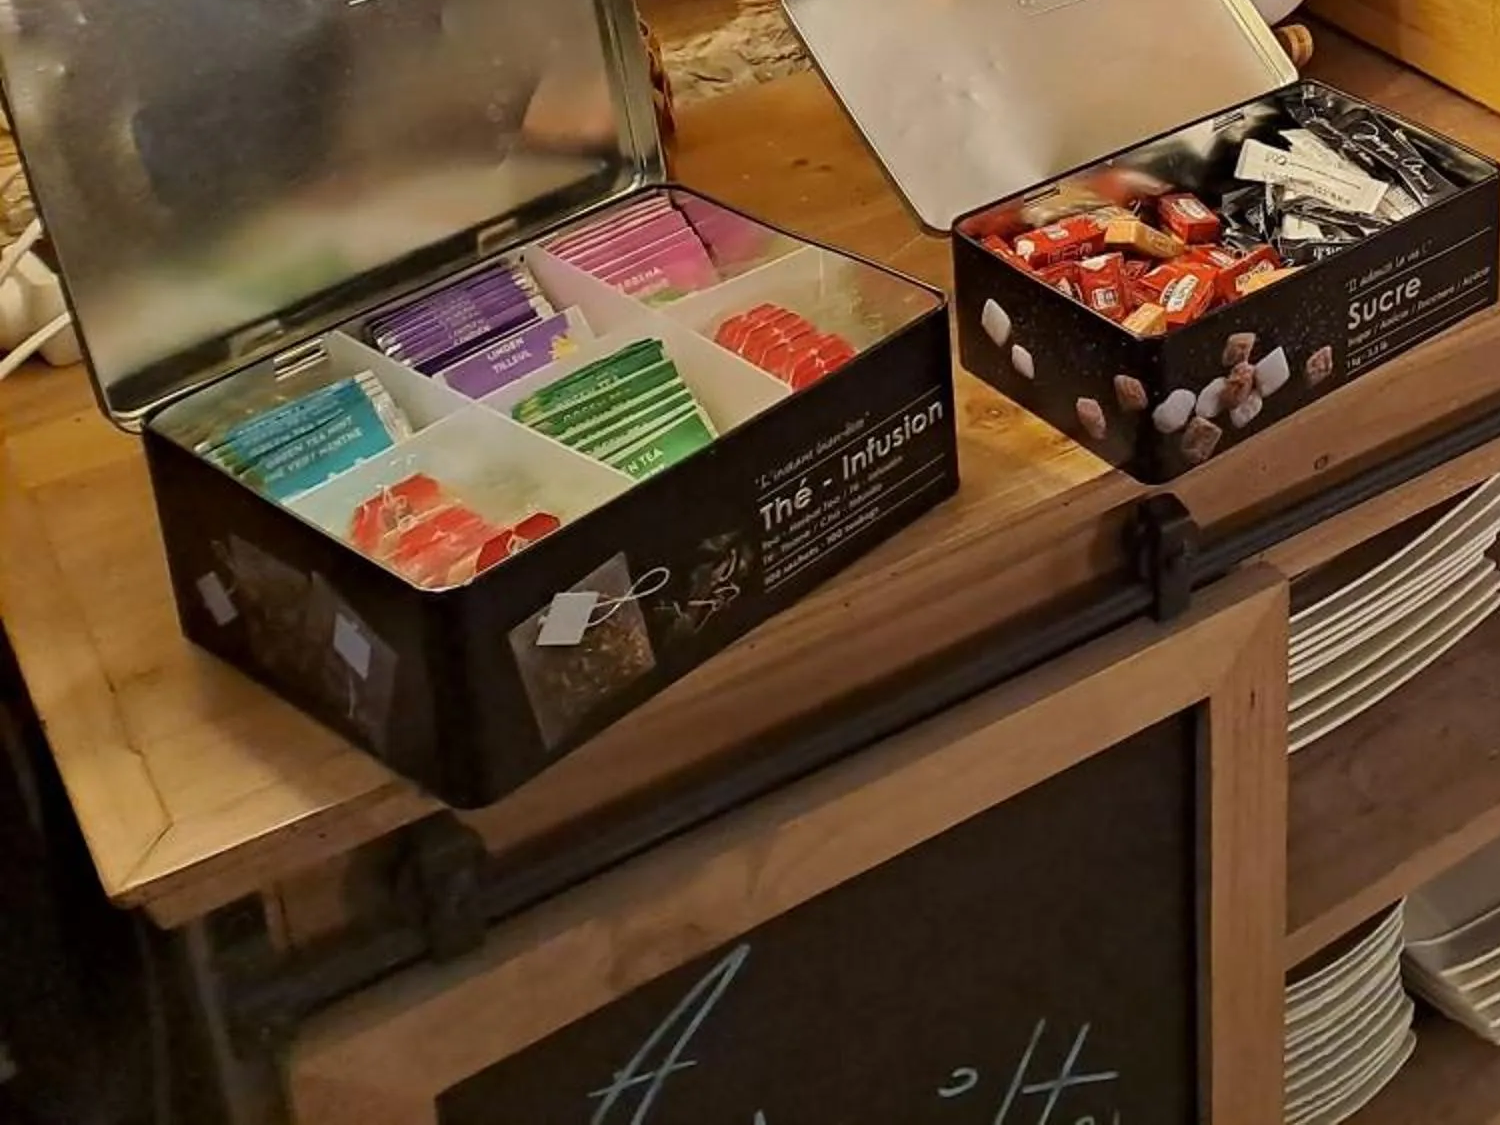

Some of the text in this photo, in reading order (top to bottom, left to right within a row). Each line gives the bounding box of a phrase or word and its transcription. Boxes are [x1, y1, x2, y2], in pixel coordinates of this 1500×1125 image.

[1347, 277, 1422, 330] Sucre
[759, 477, 813, 531] Thé
[842, 400, 944, 480] Infusion
